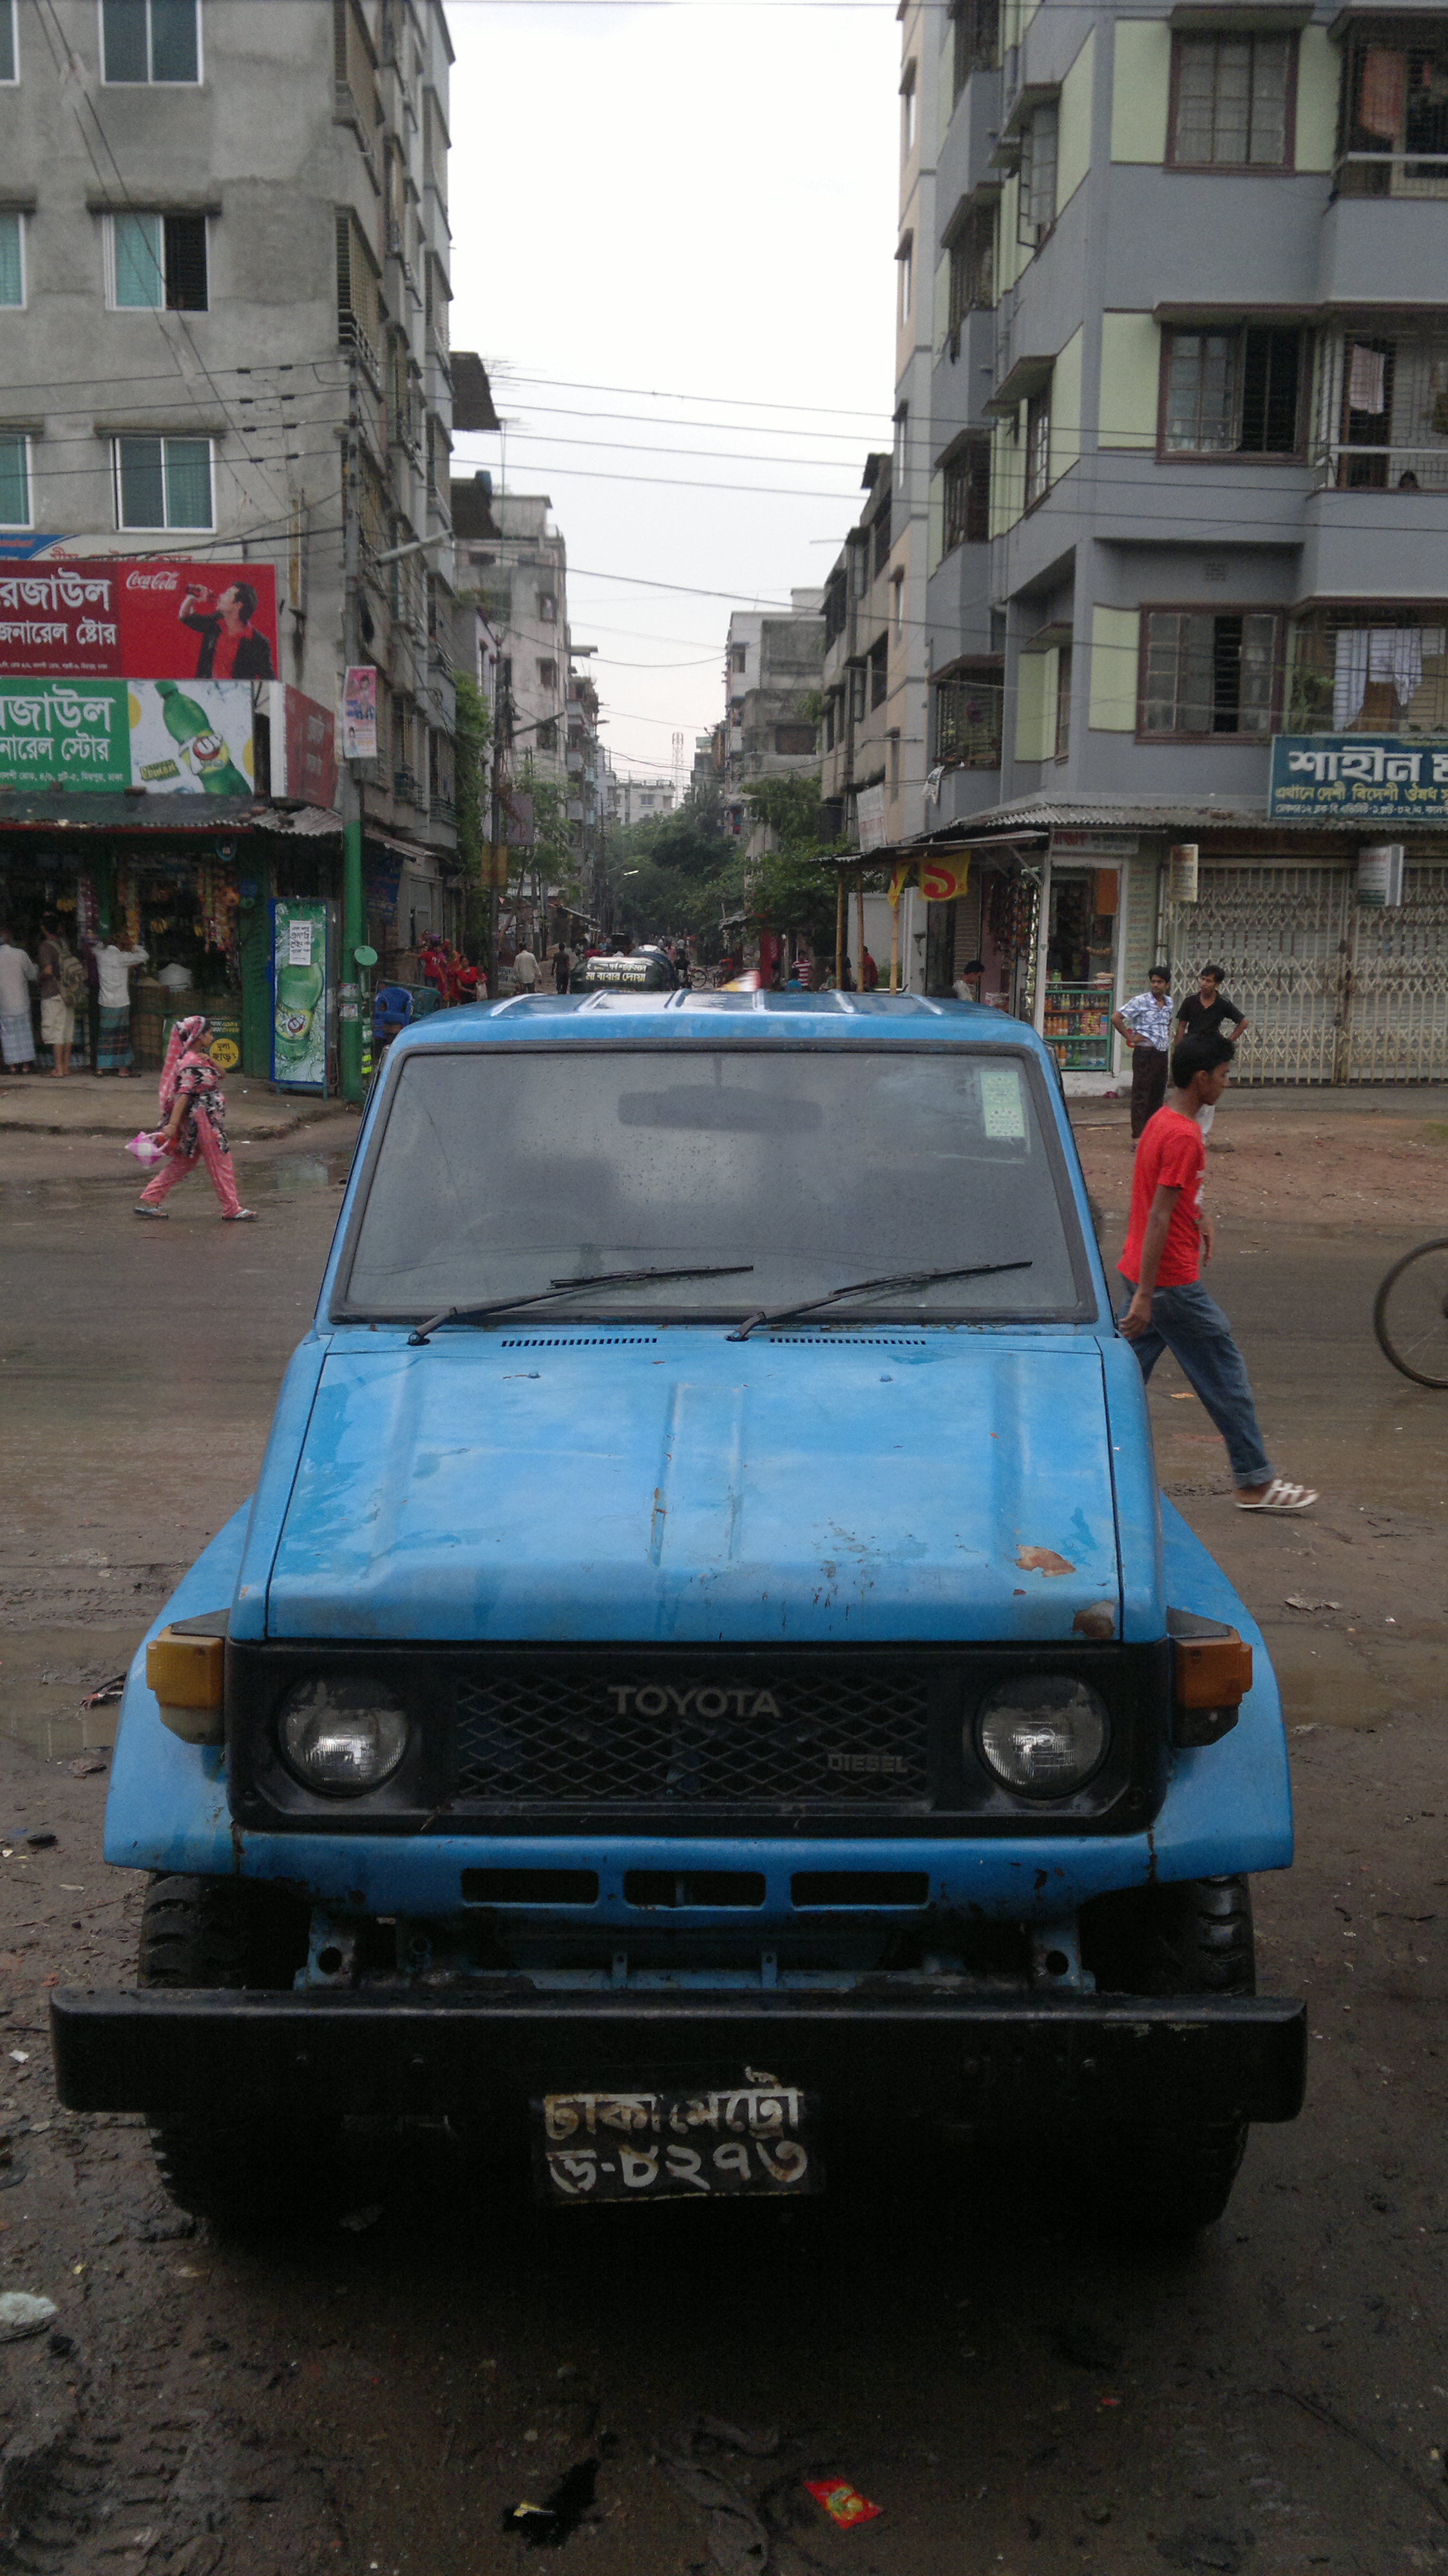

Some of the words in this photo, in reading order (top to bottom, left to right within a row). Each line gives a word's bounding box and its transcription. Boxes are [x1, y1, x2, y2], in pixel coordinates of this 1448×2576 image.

[0, 567, 111, 611] রজাউল
[0, 620, 68, 645] জনারেল
[0, 683, 116, 732] জাউল
[0, 734, 55, 761] নারেল
[1289, 745, 1424, 783] শাহীন
[586, 972, 595, 981] মা
[596, 972, 620, 981] বাবার
[622, 972, 646, 982] দোয়া
[607, 1684, 782, 1718] TOYOTA
[827, 1753, 908, 1774] DIESEL
[543, 2092, 665, 2141] ঢাকা
[669, 2065, 805, 2141] মেট্রো
